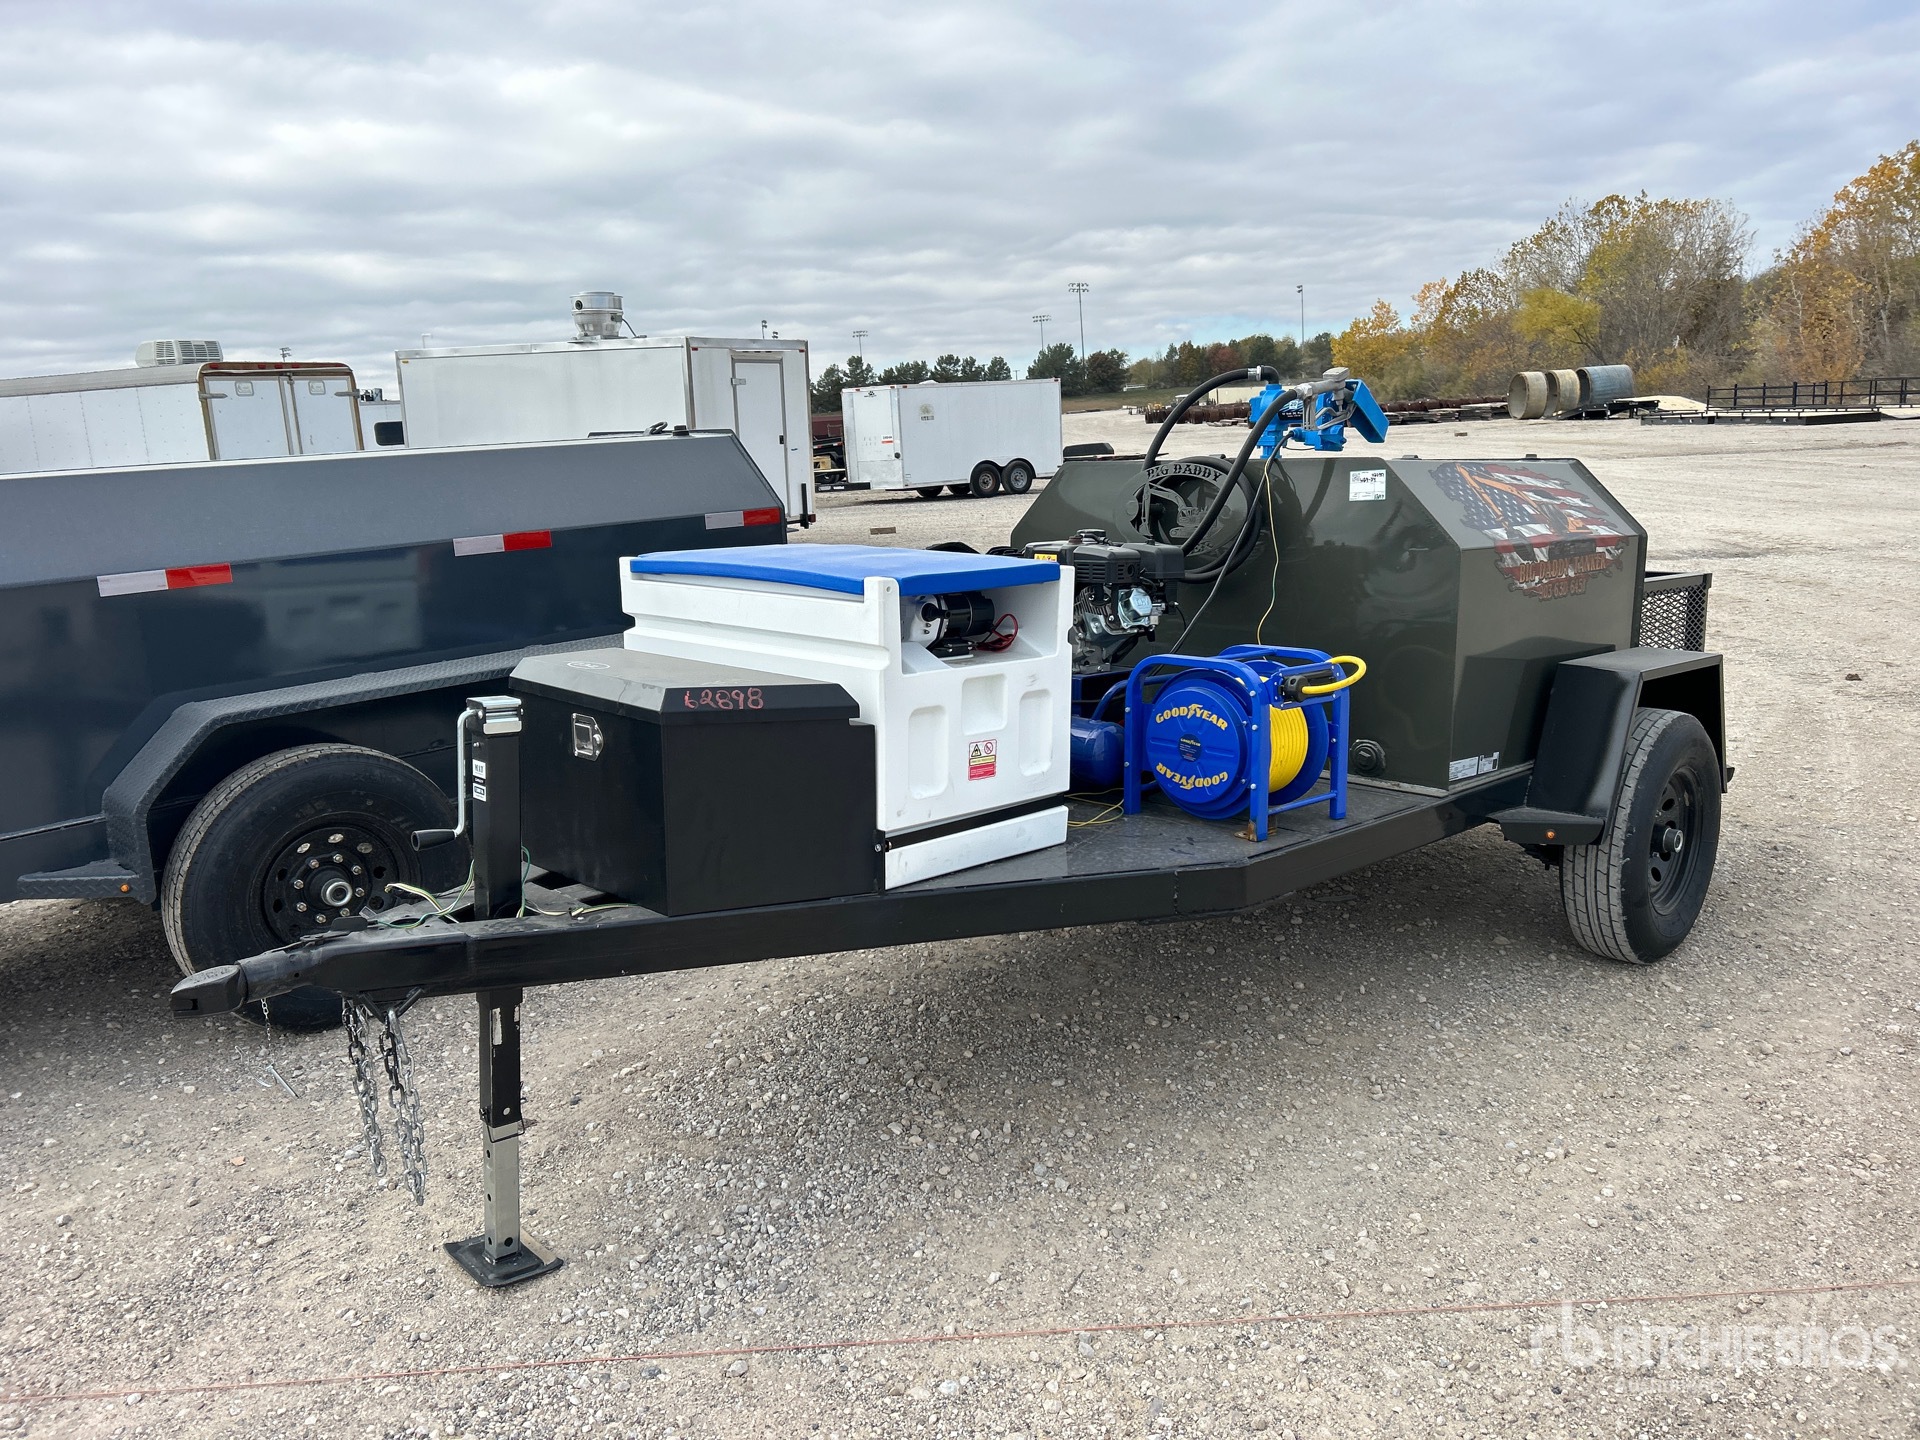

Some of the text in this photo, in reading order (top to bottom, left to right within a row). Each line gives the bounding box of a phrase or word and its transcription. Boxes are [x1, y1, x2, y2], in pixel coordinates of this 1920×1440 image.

[1146, 463, 1223, 482] BIG DADDY
[1519, 562, 1537, 583] BIG
[1574, 553, 1606, 575] TANKER
[684, 687, 764, 710] 62898
[1155, 703, 1229, 731] GOODYEAR
[1156, 762, 1229, 790] GOODYEAR
